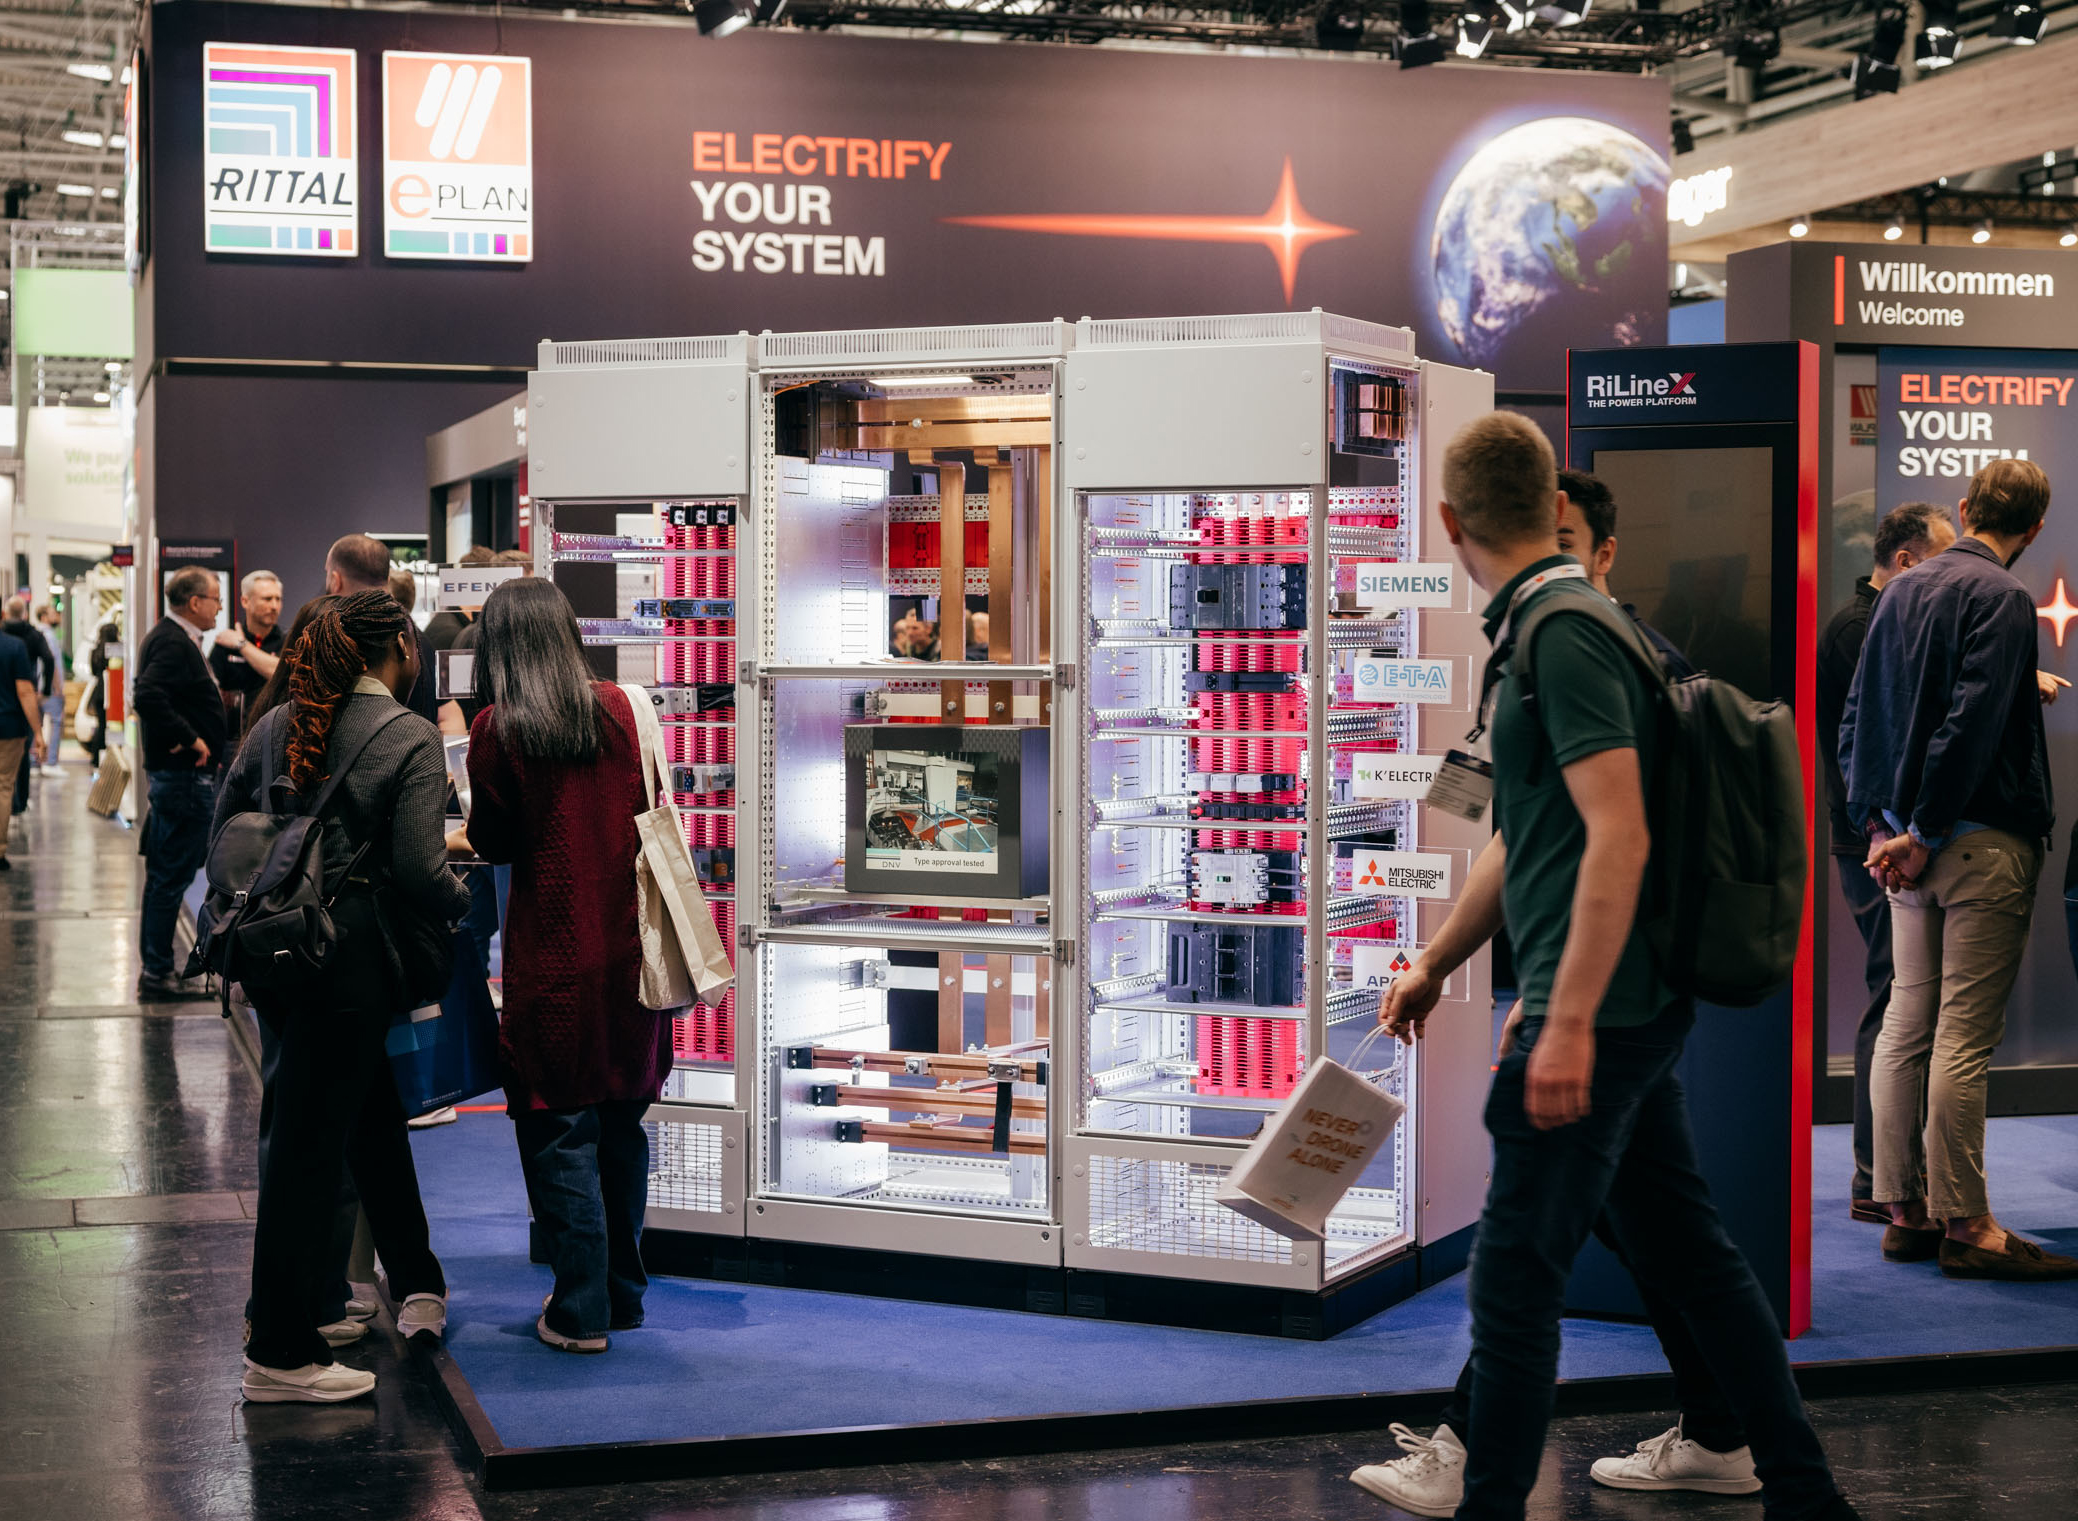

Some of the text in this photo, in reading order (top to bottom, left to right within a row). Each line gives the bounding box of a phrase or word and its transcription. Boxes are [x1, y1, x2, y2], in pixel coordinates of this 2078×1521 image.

[693, 131, 952, 181] ELECTRIFY
[210, 168, 353, 206] RITTAL
[690, 181, 832, 226] YOUR
[692, 230, 886, 277] SYSTEM
[1859, 261, 2055, 297] Willkommen
[1859, 300, 1965, 327] Welcome
[1587, 373, 1696, 397] RiLineX
[1901, 374, 2075, 406] ELECTRIFY
[1587, 397, 1697, 408] THE POWER PLATFORM
[1898, 410, 1993, 441] YOUR
[1360, 576, 1449, 593] SIEMENS
[914, 857, 985, 867] Type approval tested
[1388, 867, 1444, 880] MITSUBISHI
[1388, 877, 1437, 889] ELECTRIC
[1302, 1108, 1359, 1136] NEVER
[1305, 1131, 1366, 1159] DRONE
[1286, 1147, 1346, 1174] ALONE
